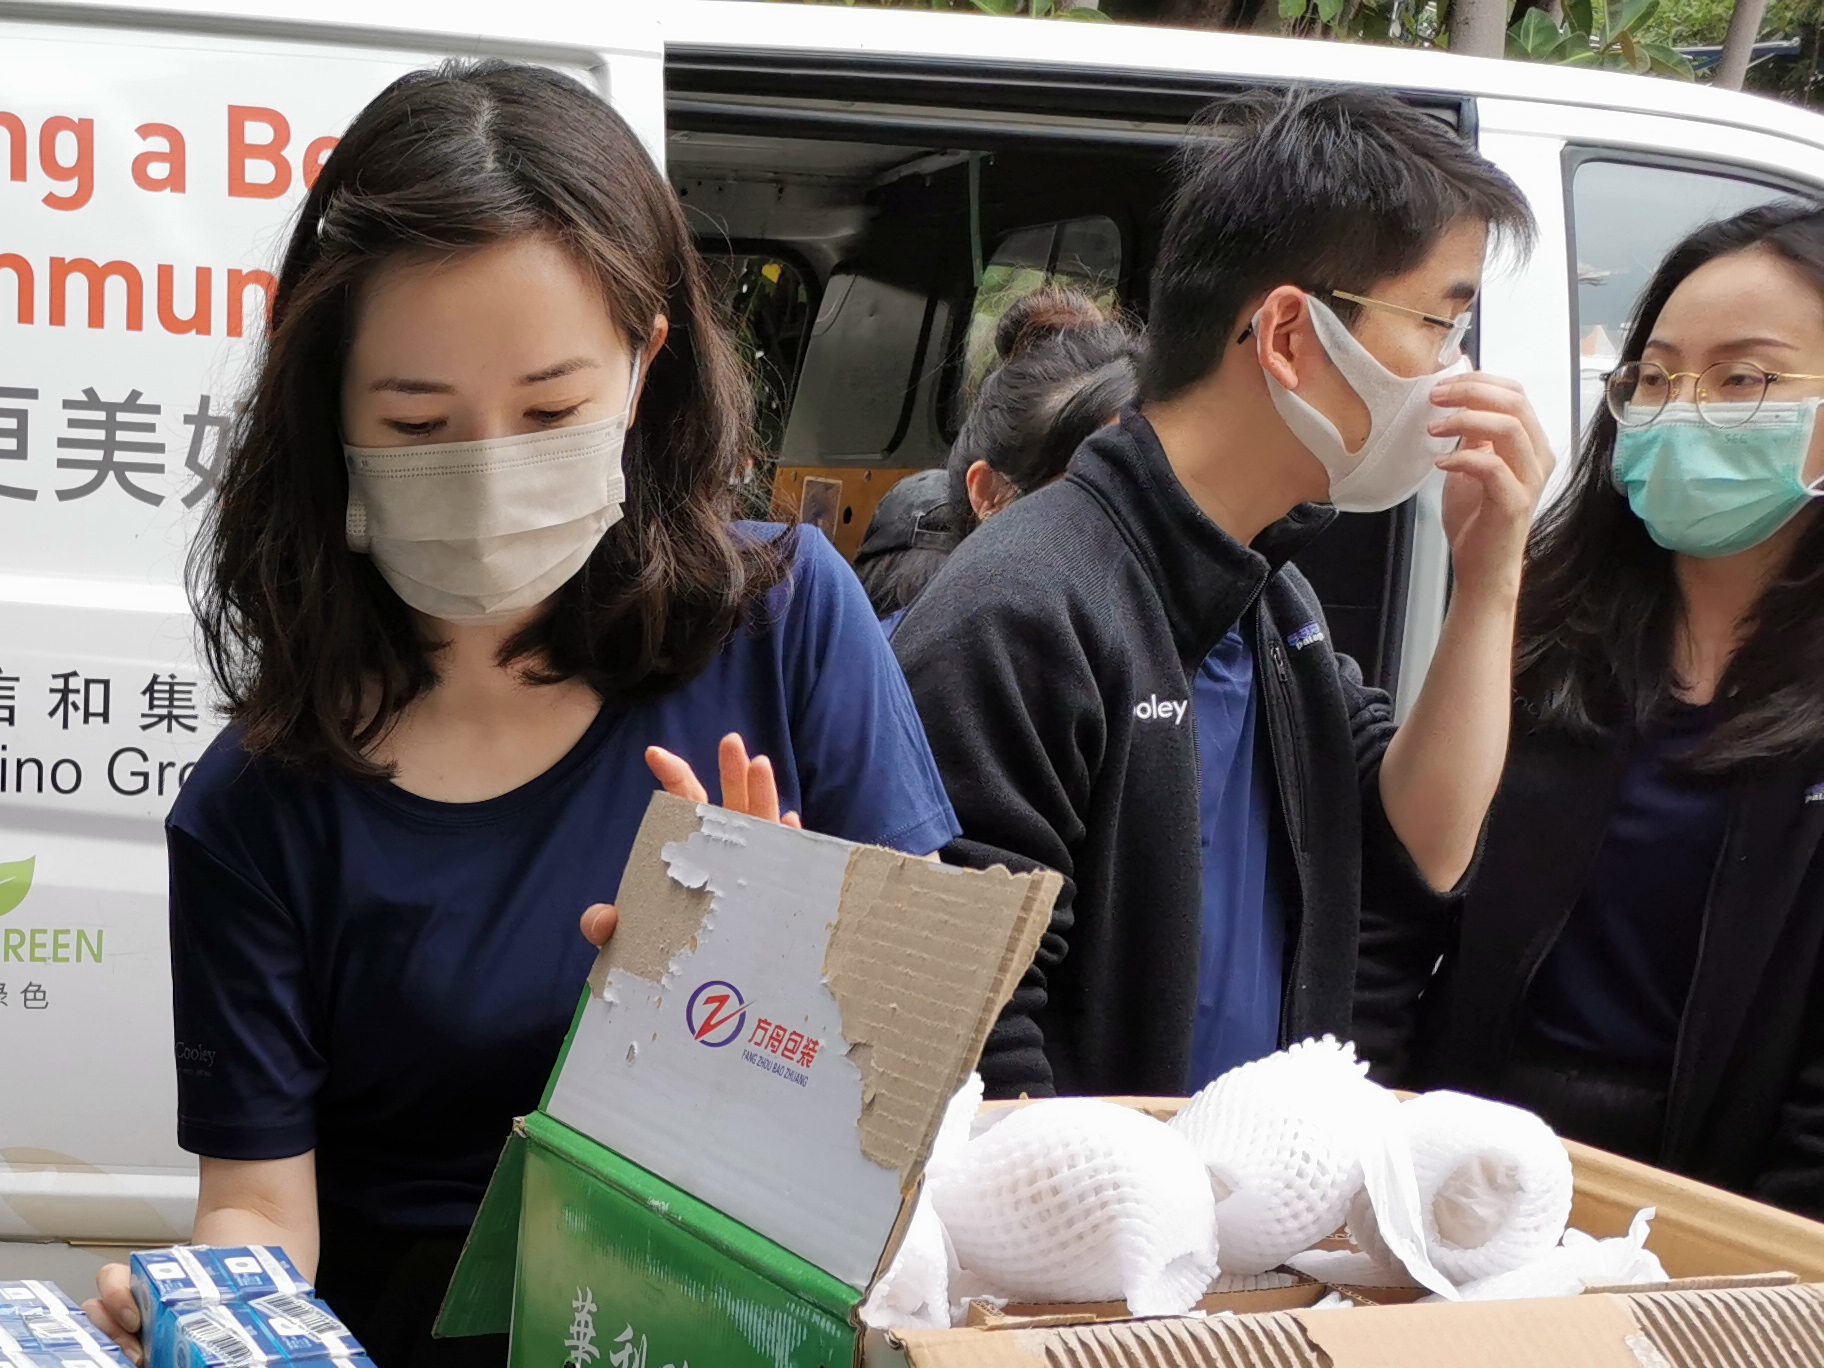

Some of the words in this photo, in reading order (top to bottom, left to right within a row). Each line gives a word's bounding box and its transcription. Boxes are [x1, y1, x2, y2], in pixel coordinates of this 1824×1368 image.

[131, 126, 187, 194] a
[1133, 694, 1188, 725] oley
[175, 1041, 216, 1067] Cooley
[748, 1018, 820, 1069] 方舟包装
[741, 1048, 758, 1066] FANG
[756, 1055, 773, 1071] ZHOU
[783, 1067, 809, 1088] ZHUANG
